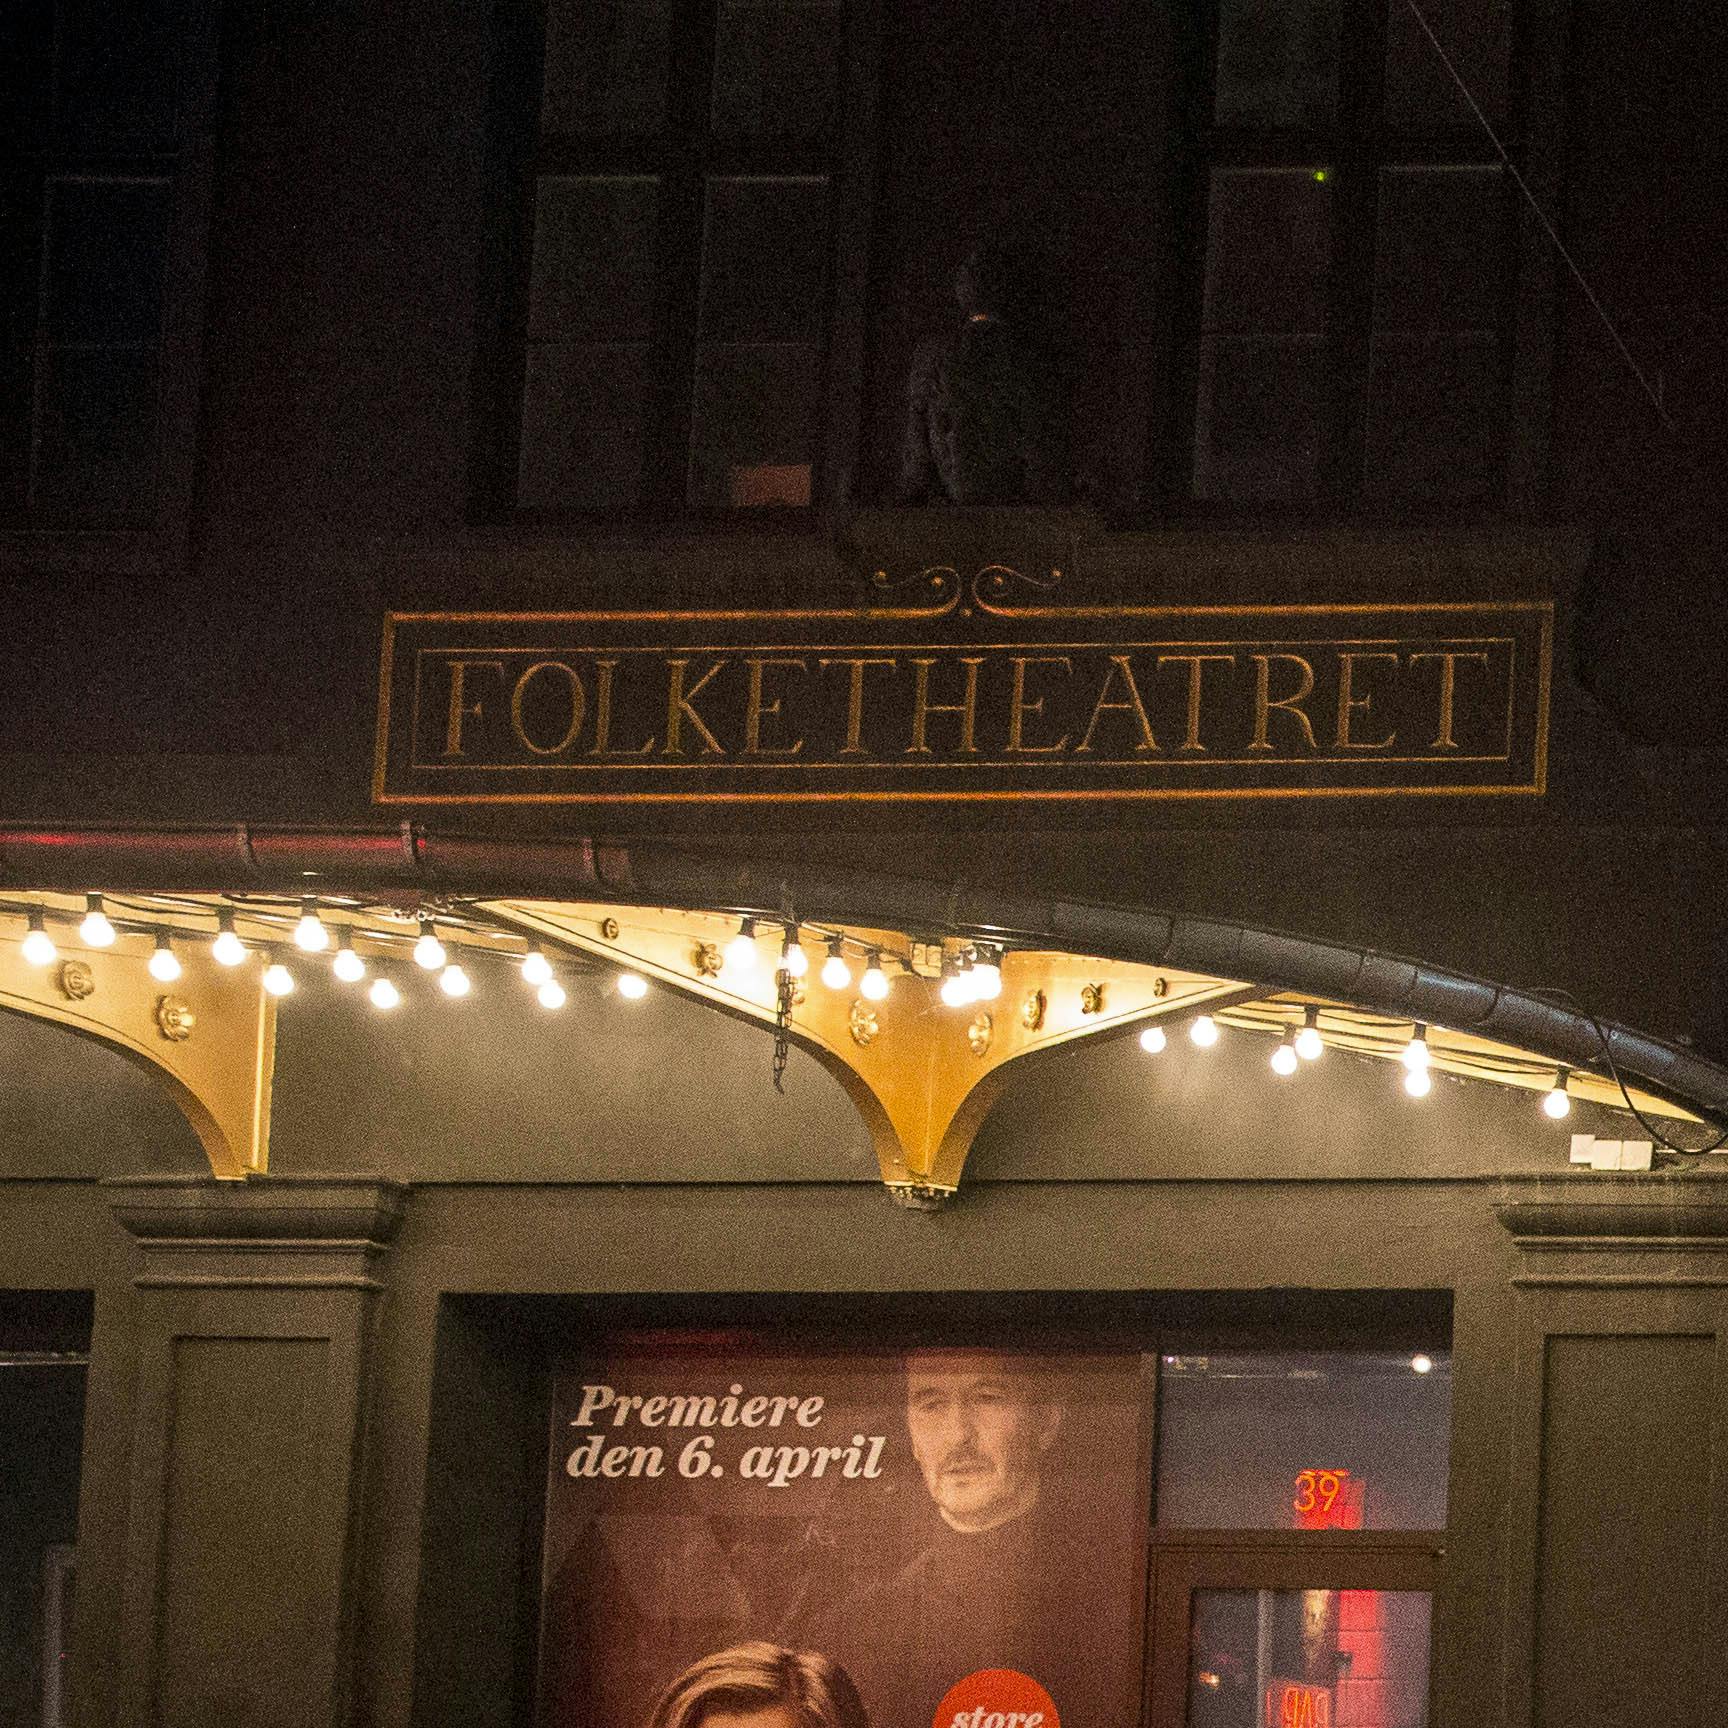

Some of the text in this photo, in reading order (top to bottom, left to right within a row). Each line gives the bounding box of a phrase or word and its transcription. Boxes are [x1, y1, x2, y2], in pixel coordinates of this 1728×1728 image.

[444, 652, 1487, 756] FOLKETHEATRET
[571, 1384, 824, 1428] Premiere
[567, 1436, 885, 1487] den 6. april
[1294, 1474, 1339, 1511] 39
